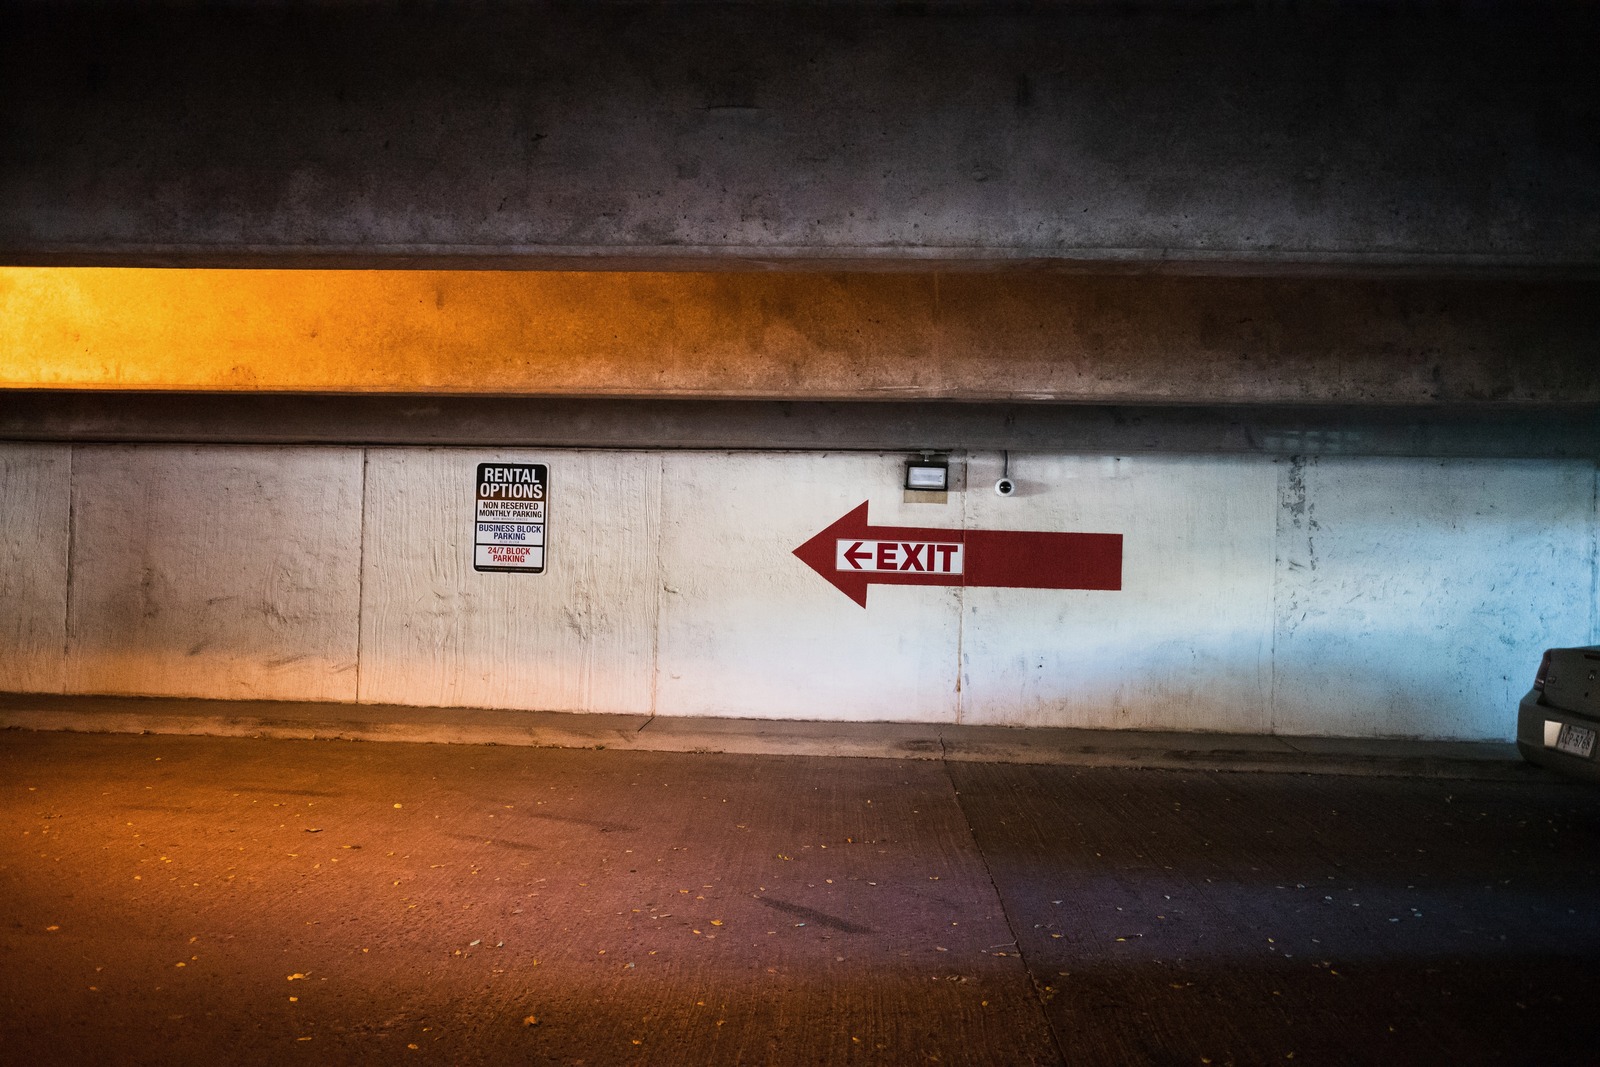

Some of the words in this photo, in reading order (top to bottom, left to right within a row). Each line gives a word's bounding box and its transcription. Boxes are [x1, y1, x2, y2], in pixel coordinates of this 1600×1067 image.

[484, 468, 540, 483] RENTAL
[480, 483, 543, 499] OPTIONS
[483, 501, 499, 510] NON
[501, 502, 539, 510] RESERVED
[479, 509, 511, 517] MONTHLY
[512, 510, 542, 518] PARKING
[478, 524, 515, 533] BUSINESS
[517, 525, 541, 533] BLOCK
[493, 532, 526, 541] PARKING
[487, 547, 504, 555] 24/7
[506, 547, 531, 555] BLOCK
[492, 554, 525, 563] PARKING
[877, 542, 959, 572] EXIT
